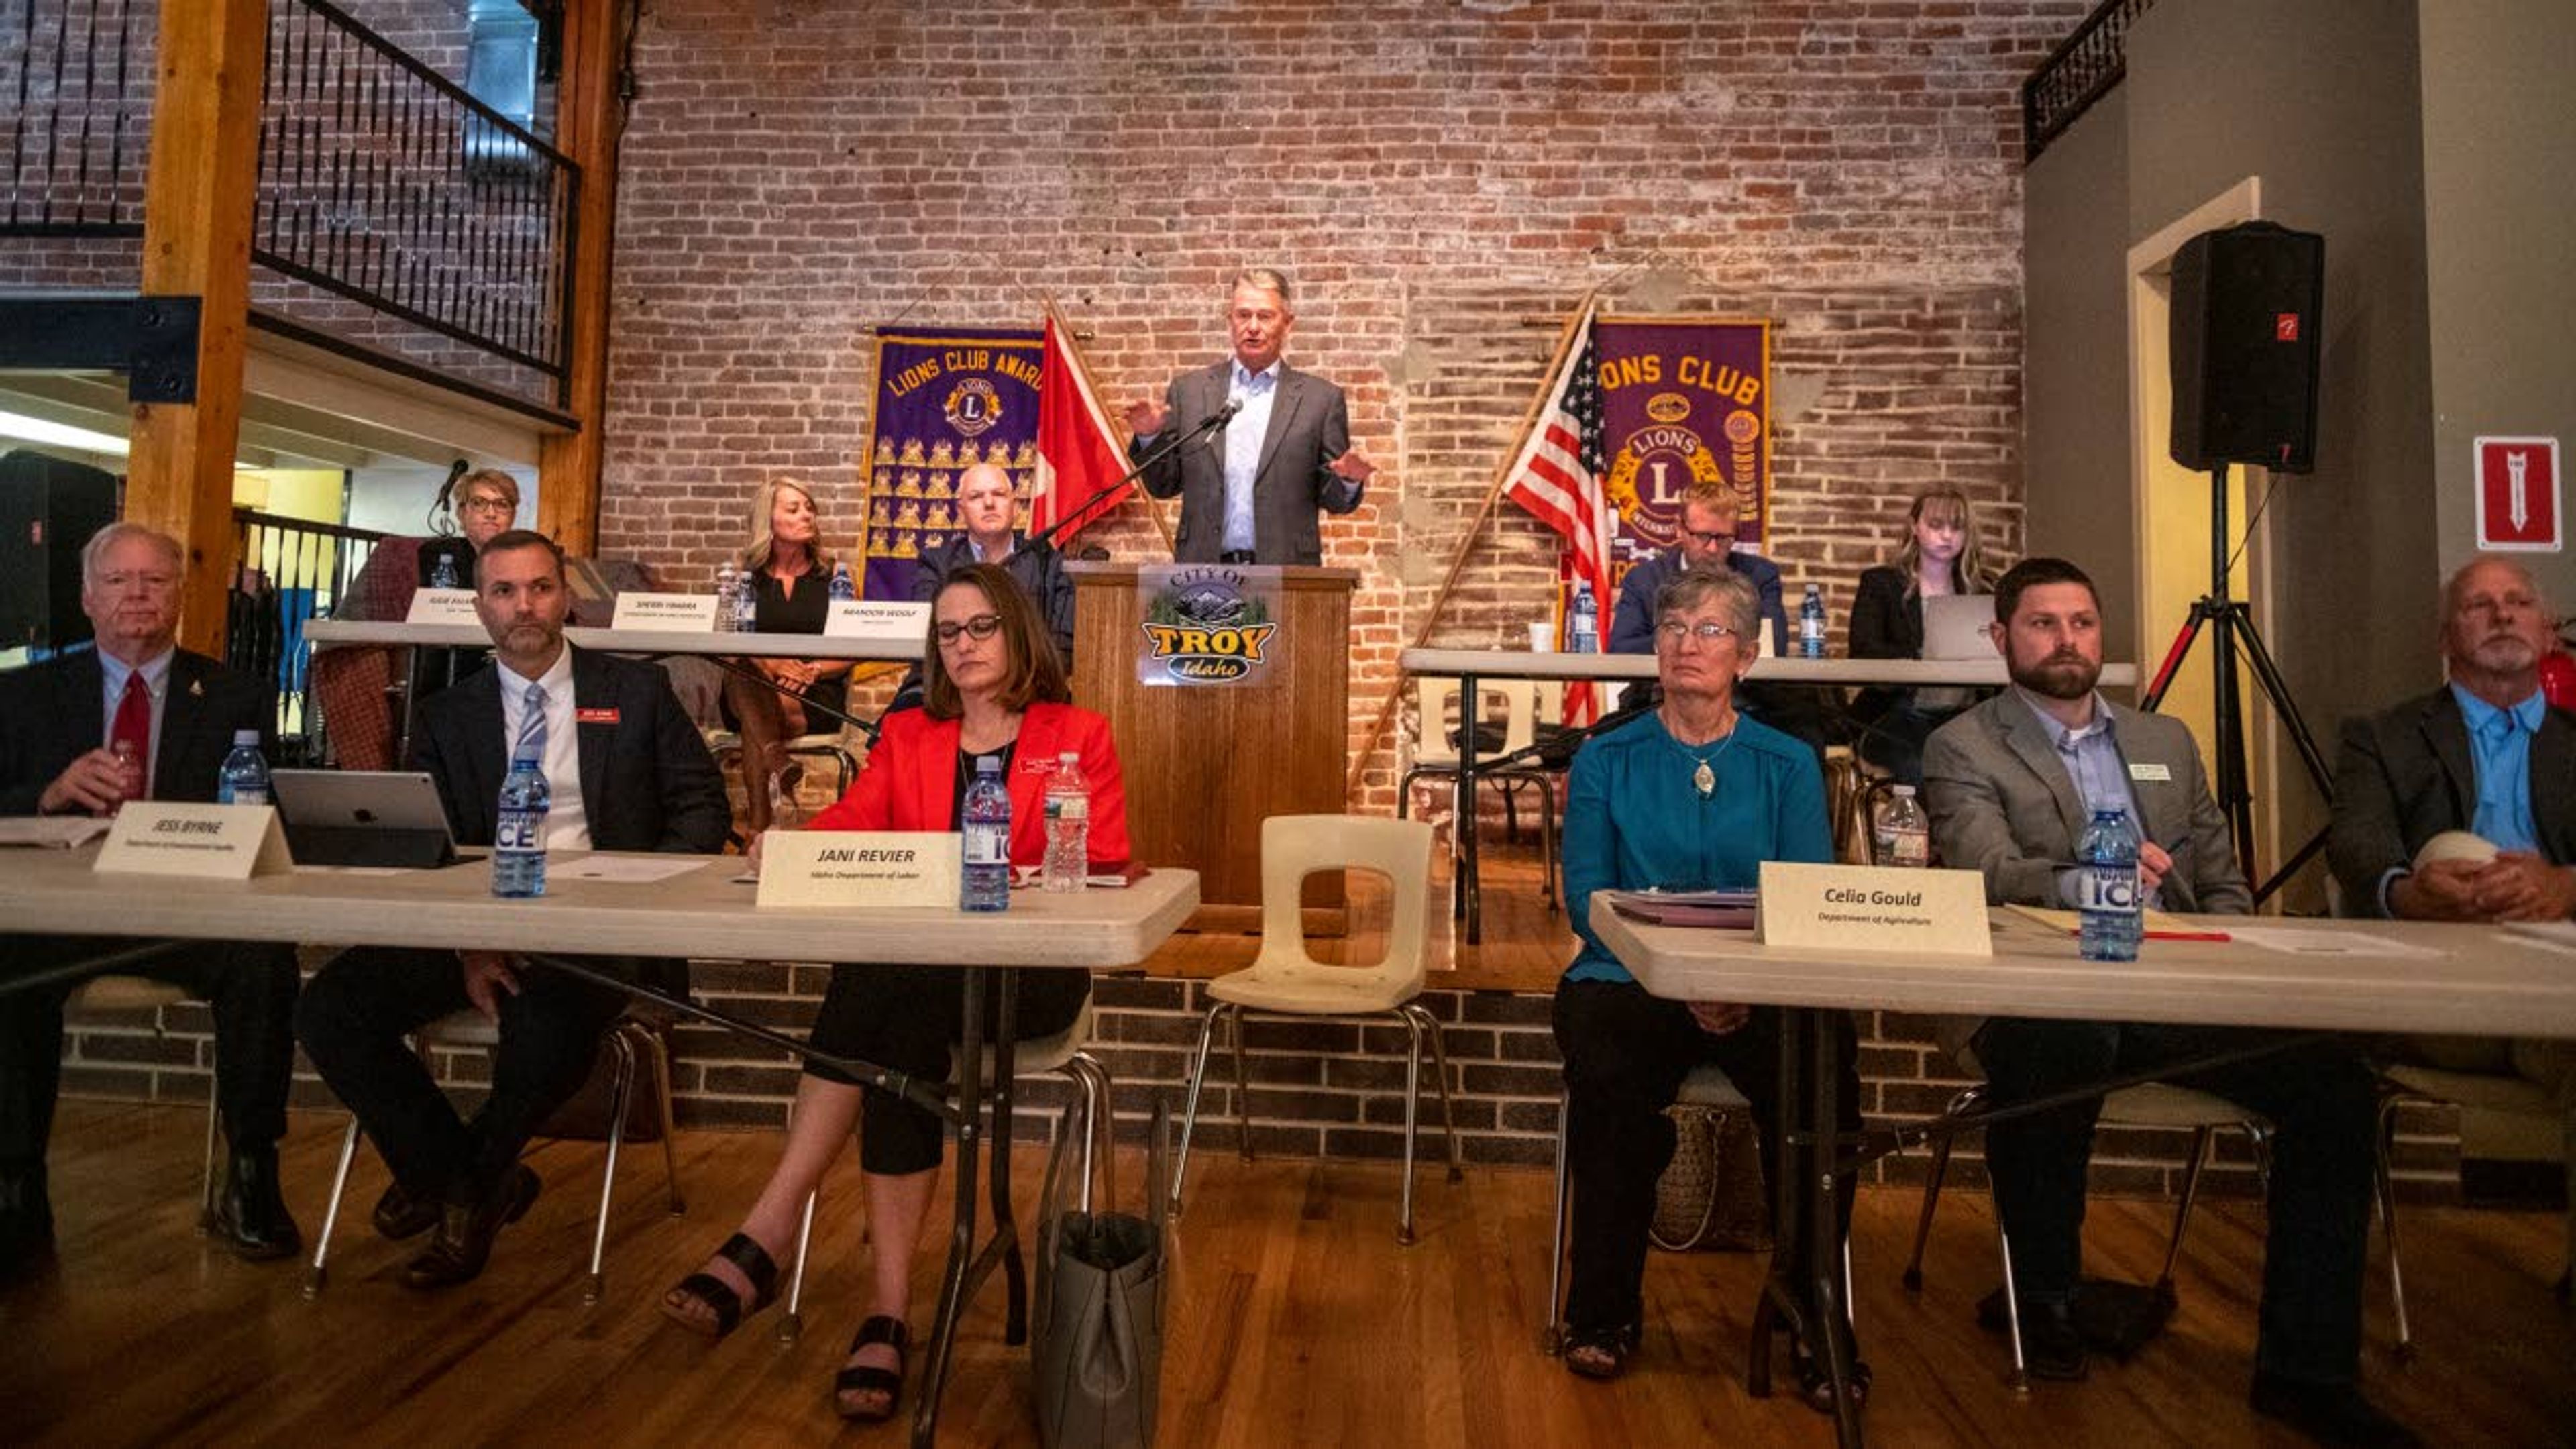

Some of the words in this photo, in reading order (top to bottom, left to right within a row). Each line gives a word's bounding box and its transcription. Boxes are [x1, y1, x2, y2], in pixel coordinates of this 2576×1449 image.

[887, 358, 941, 397] LIONS
[945, 350, 989, 371] CLUB
[1600, 354, 1662, 390] ONS
[1678, 356, 1760, 405] CLUB
[964, 396, 980, 417] L
[1634, 430, 1697, 455] LIONS
[1650, 463, 1682, 504] L
[1170, 568, 1217, 587] CITY
[1150, 627, 1269, 659] TROY
[1182, 659, 1238, 677] Idaho
[152, 820, 181, 832] JESS
[181, 820, 223, 834] BYRNE
[497, 824, 534, 847] CE
[817, 849, 855, 862] JANI
[858, 849, 916, 862] REVIER
[1824, 888, 1867, 904] Celia
[1871, 891, 1922, 907] Gould
[1818, 912, 1871, 922] Department
[1872, 916, 1882, 924] of
[1883, 916, 1932, 926] Agriculture
